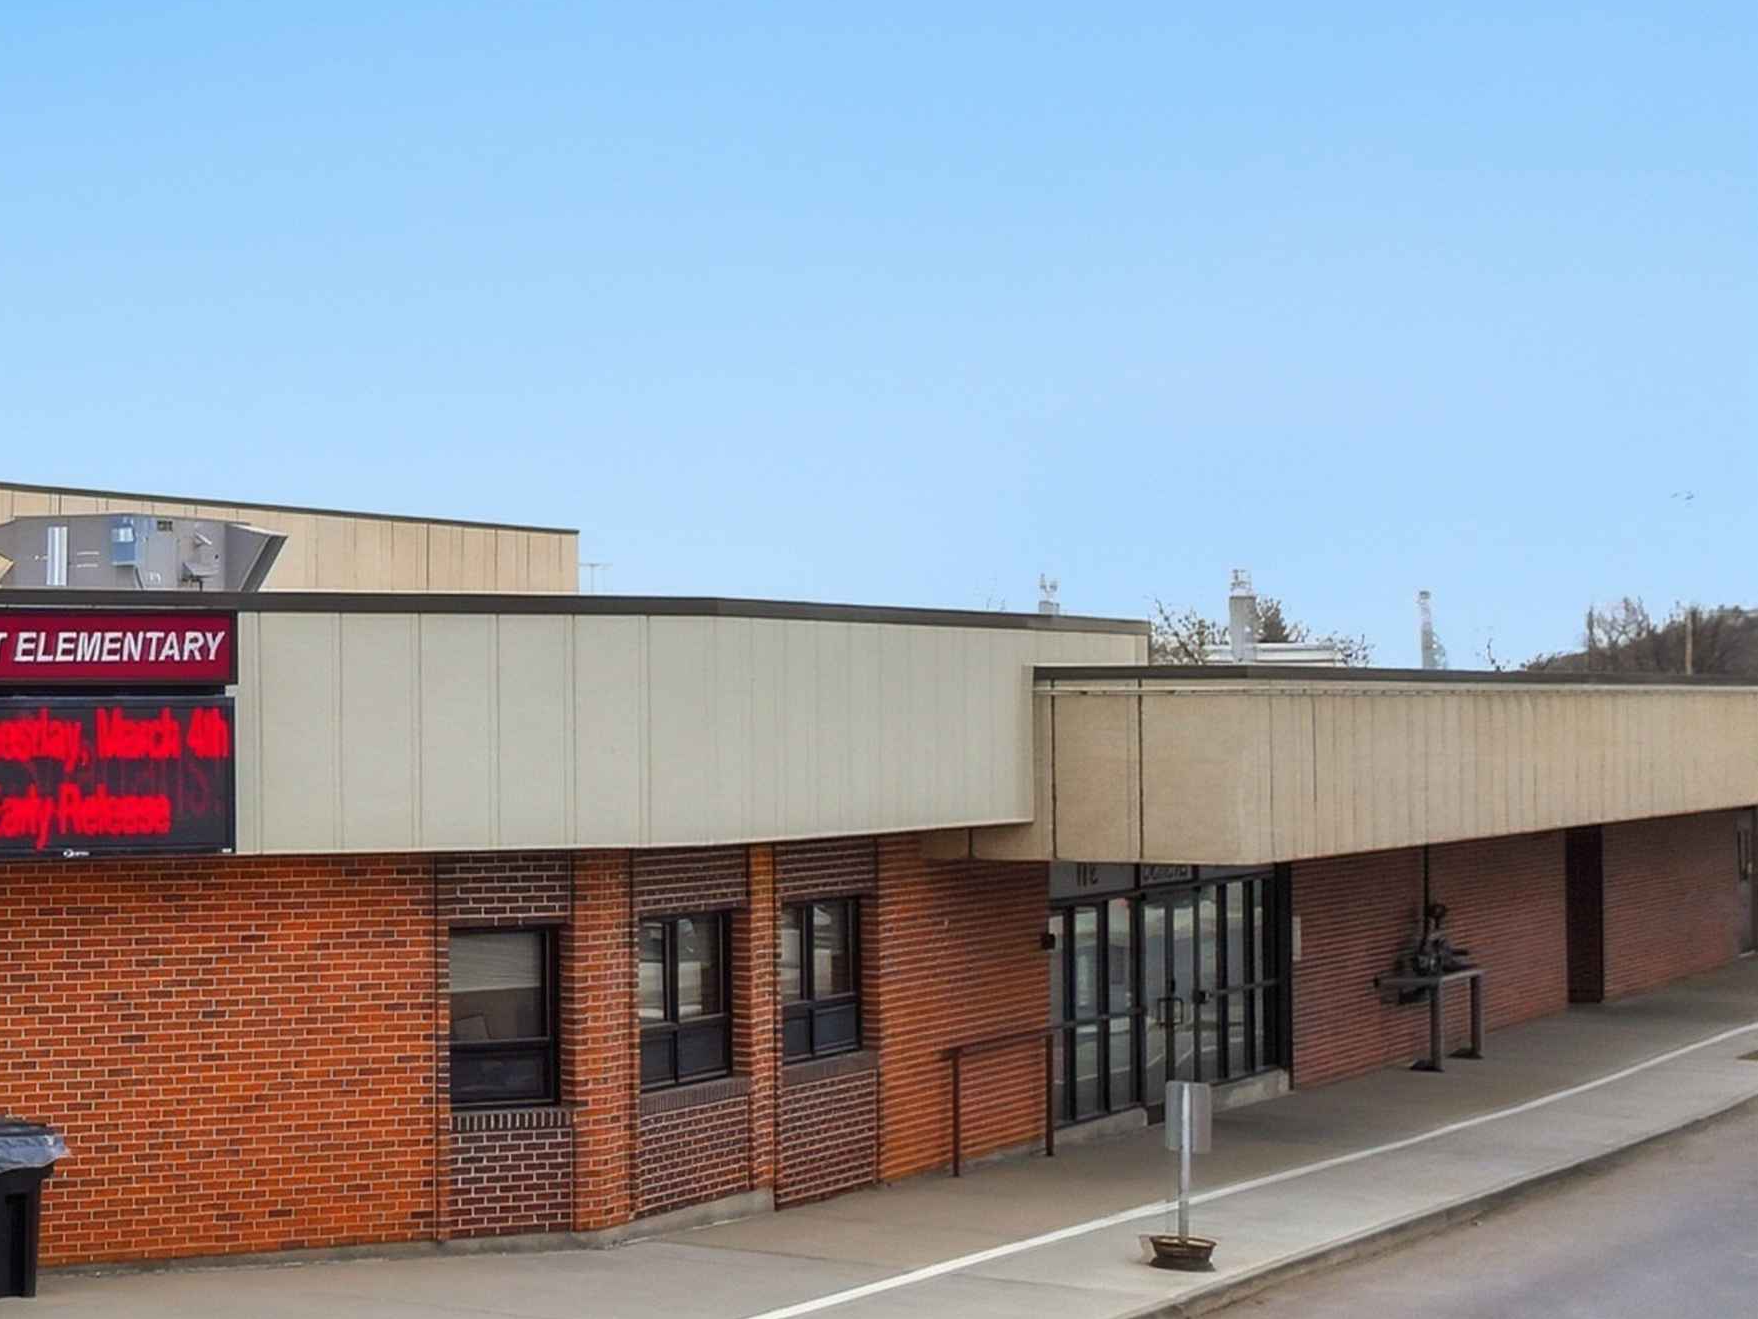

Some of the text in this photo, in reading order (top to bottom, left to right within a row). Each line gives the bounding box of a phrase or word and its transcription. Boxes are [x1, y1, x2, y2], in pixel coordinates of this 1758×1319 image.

[14, 631, 225, 662] ELEMENTARY
[95, 707, 181, 759] March
[57, 783, 172, 836] Release
